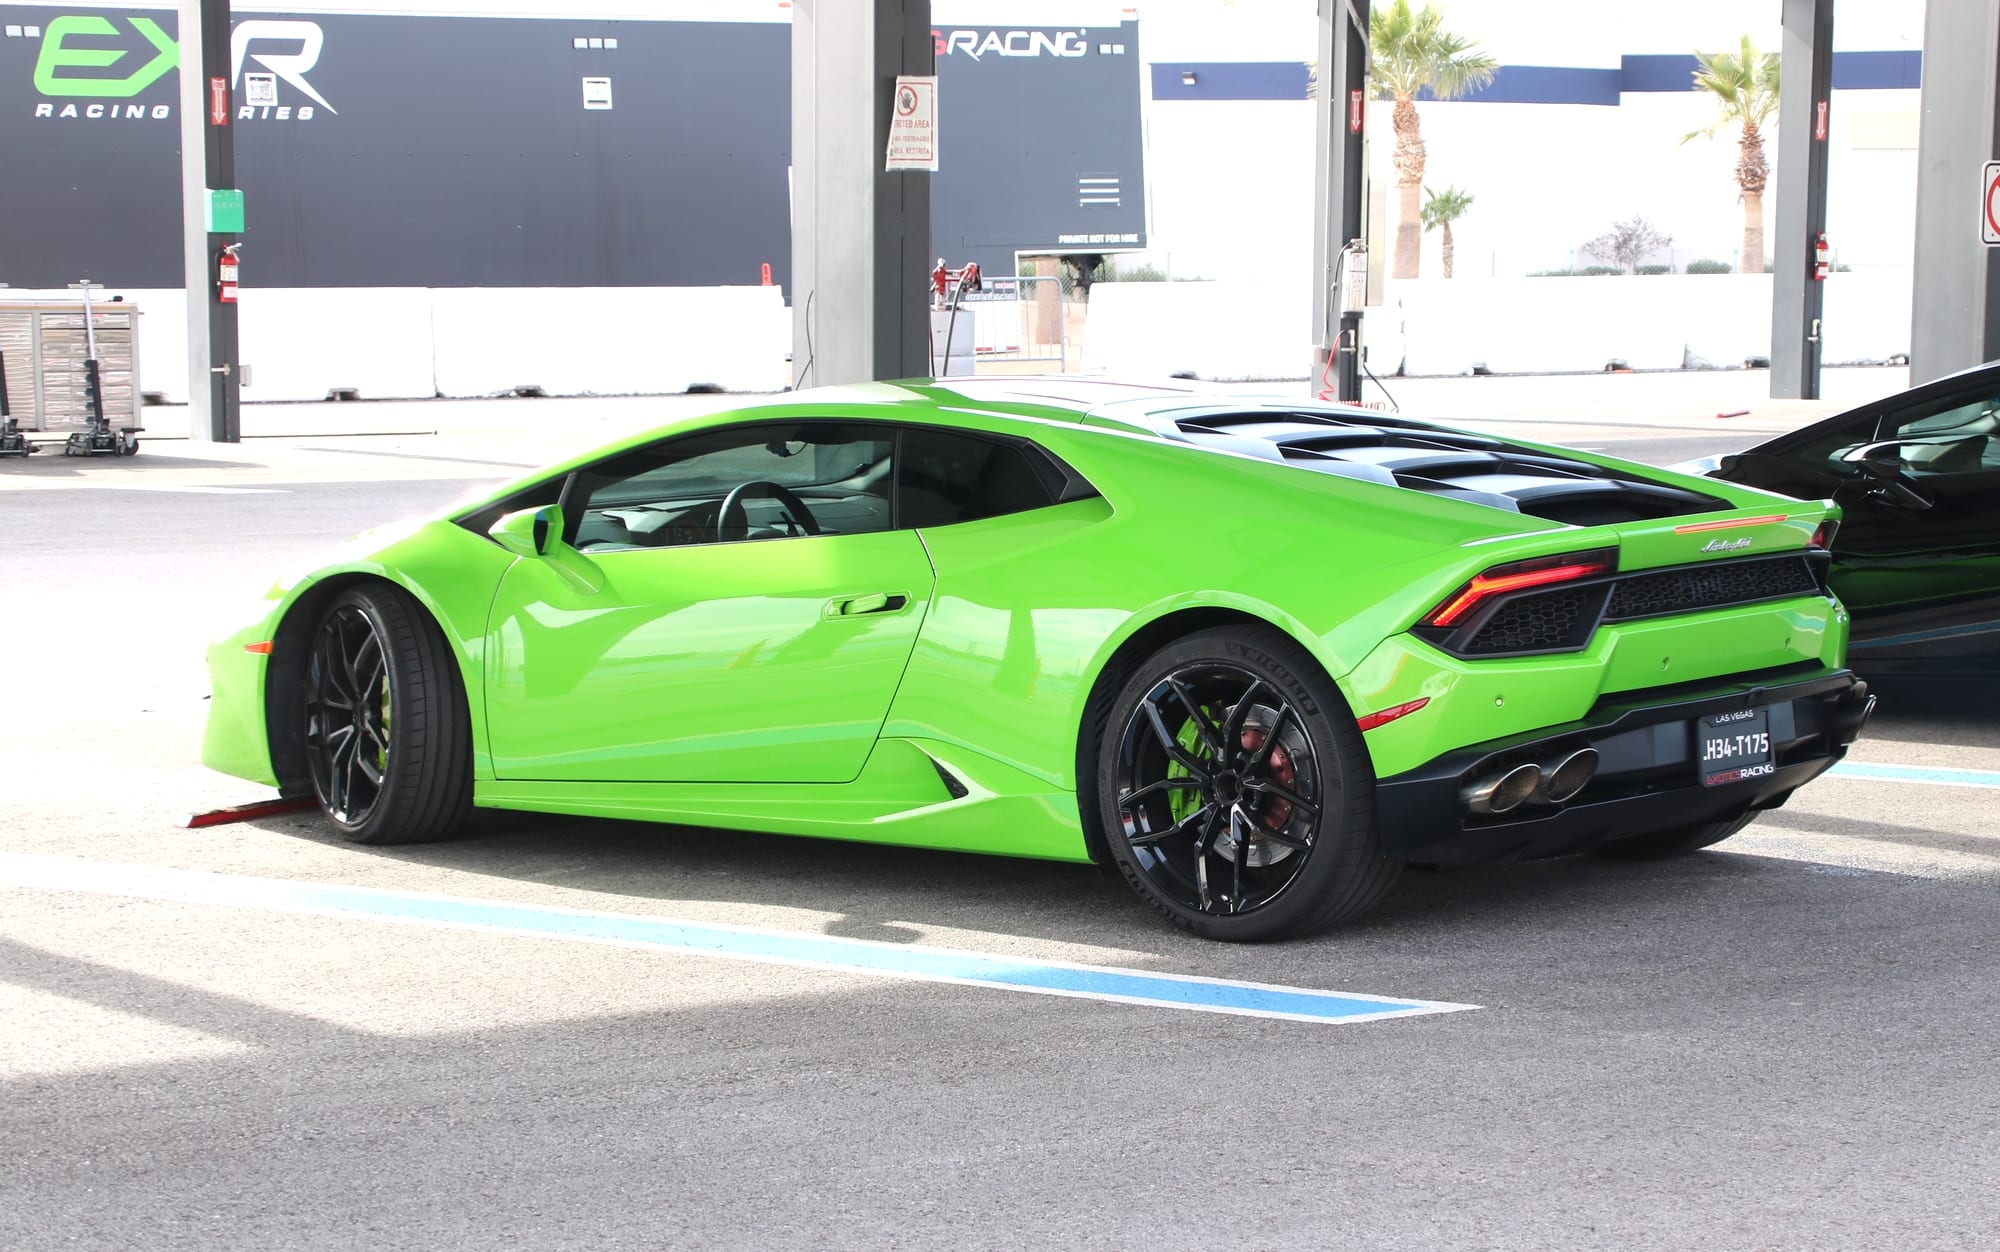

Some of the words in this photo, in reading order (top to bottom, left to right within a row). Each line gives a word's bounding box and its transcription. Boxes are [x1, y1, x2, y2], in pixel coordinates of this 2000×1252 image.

[35, 103, 170, 119] RACING
[238, 106, 315, 120] RIES
[914, 119, 930, 128] AREA
[1058, 234, 1088, 244] PRIVATE
[1089, 234, 1105, 243] NOT
[1105, 233, 1121, 243] FOR
[1245, 648, 1316, 715] MICHELIN
[1715, 714, 1730, 724] LAS
[1730, 709, 1754, 721] VEGAS
